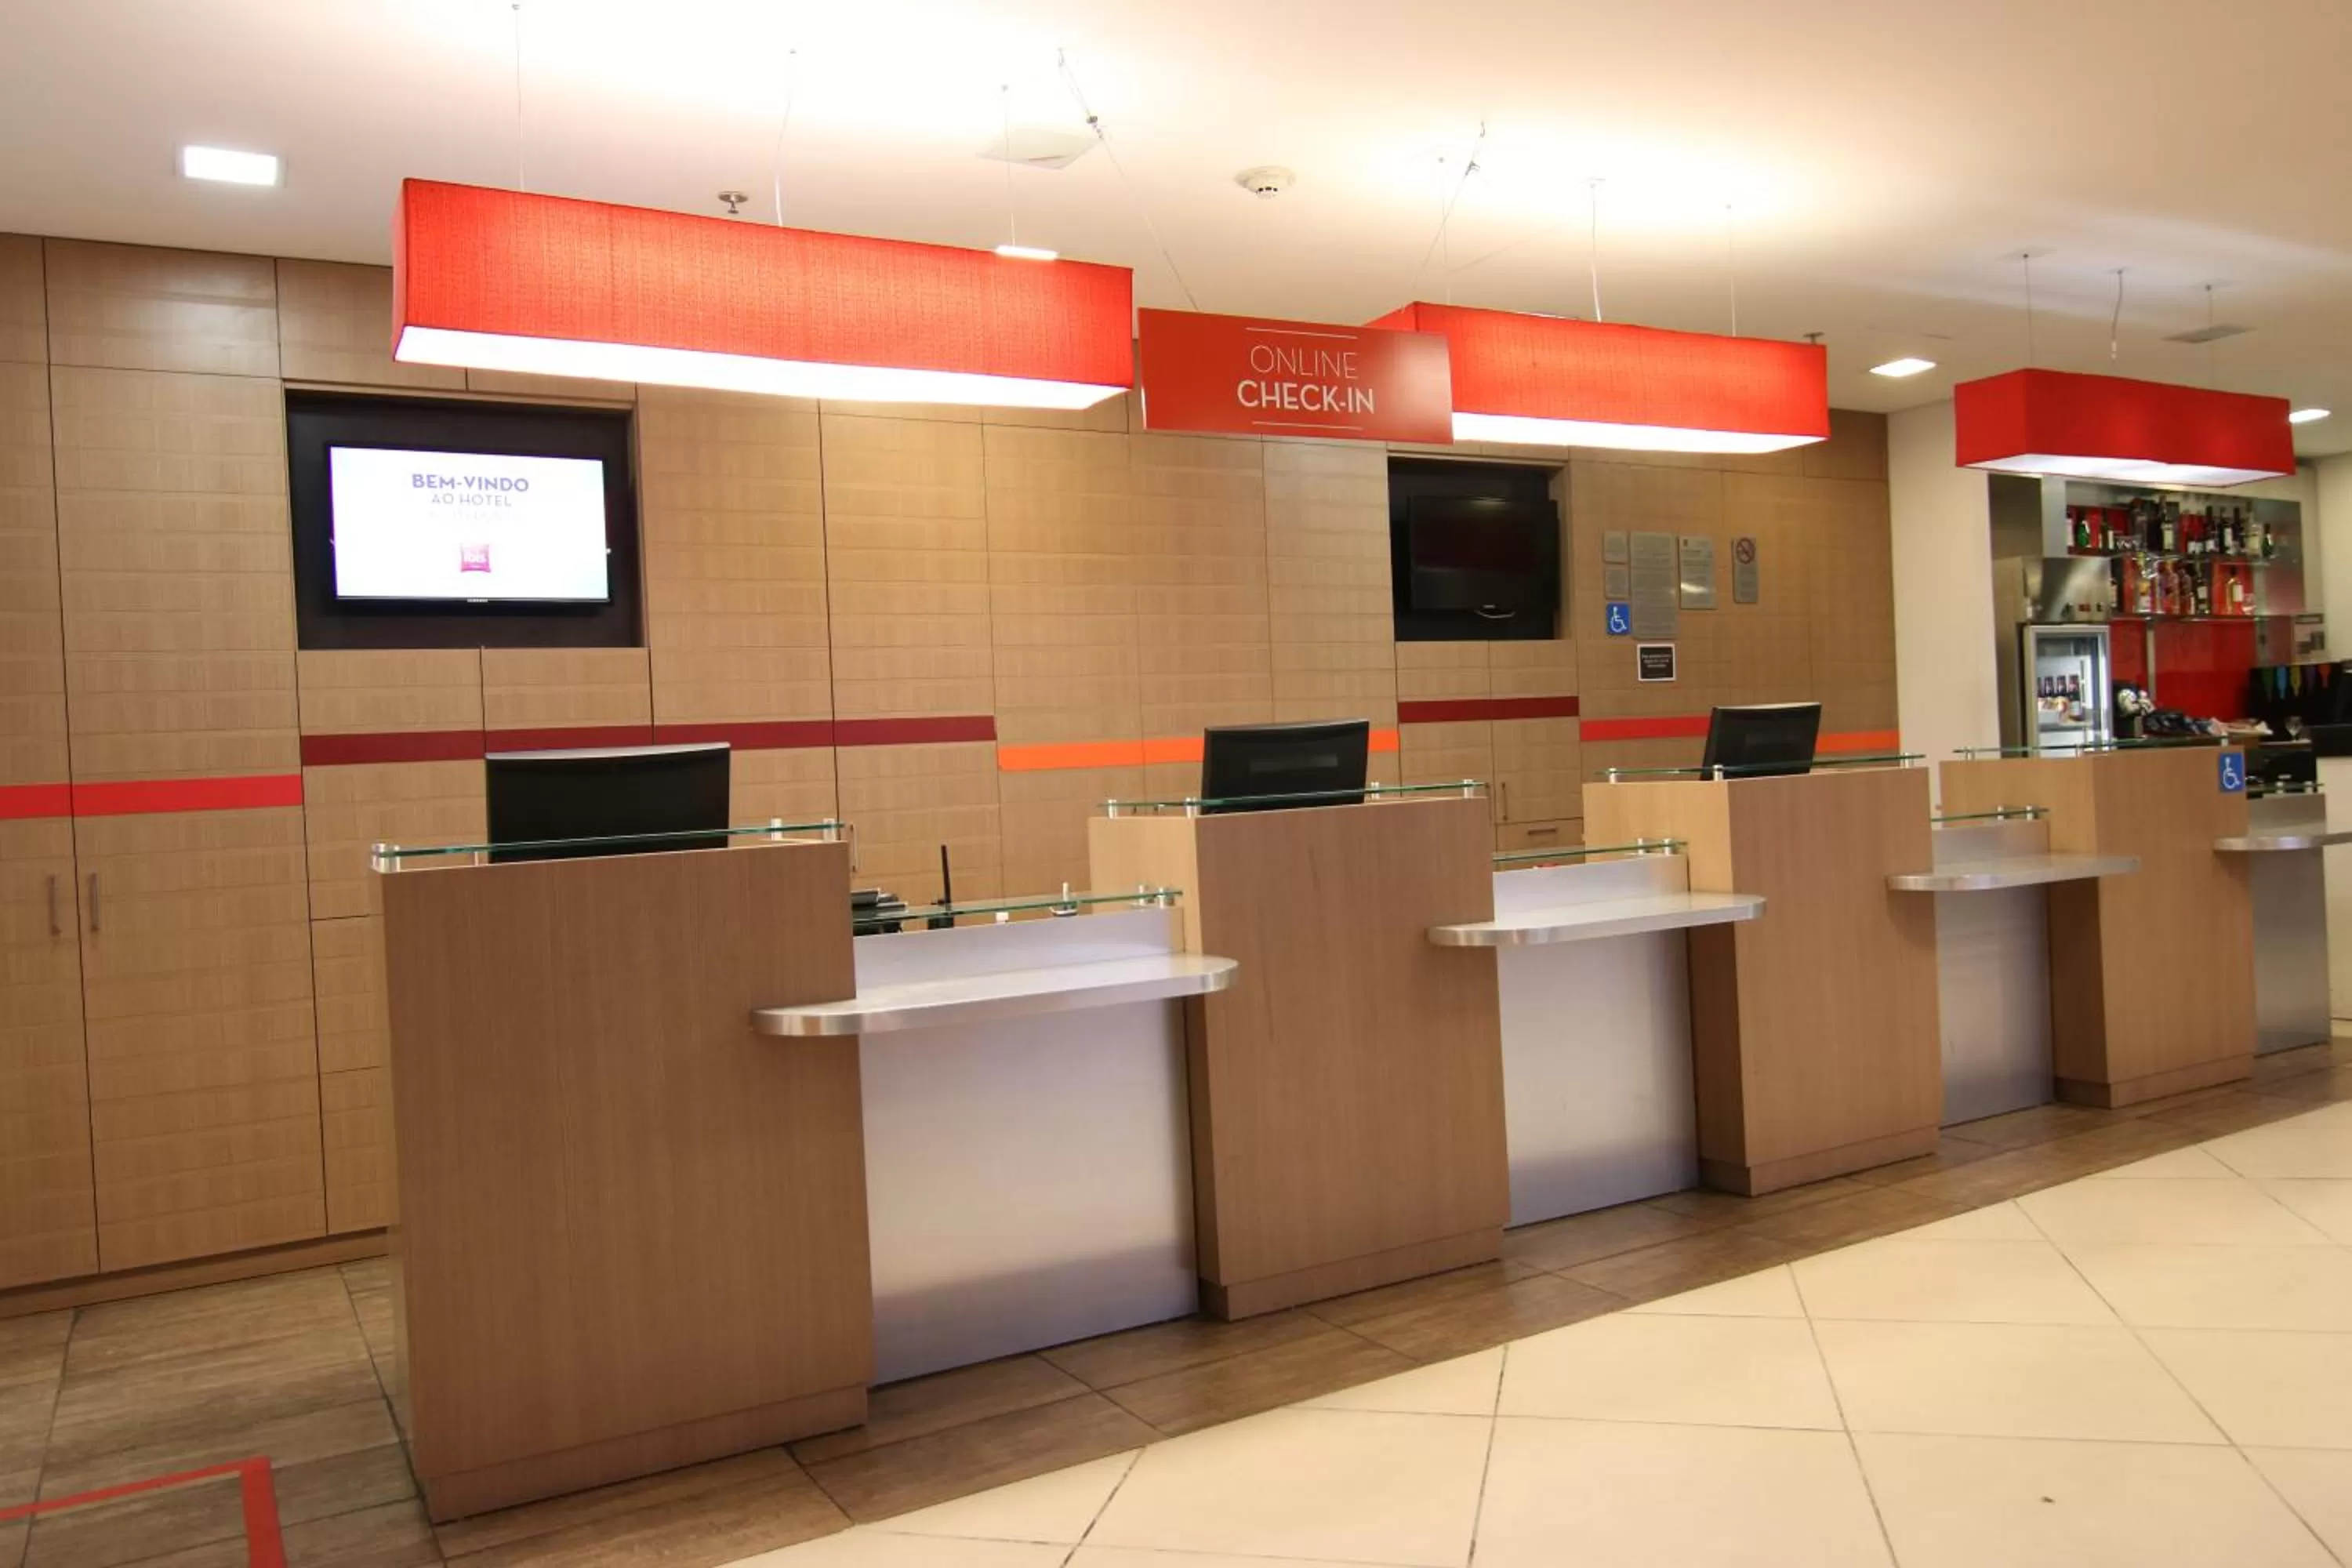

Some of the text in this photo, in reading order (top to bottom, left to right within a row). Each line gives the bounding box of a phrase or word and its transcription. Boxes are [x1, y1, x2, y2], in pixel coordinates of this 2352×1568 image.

[1250, 344, 1359, 379] ONLINE
[1236, 379, 1374, 414] CHECK-IN
[412, 474, 529, 492] BEM-VINDO
[432, 493, 512, 507] AO HOTEL
